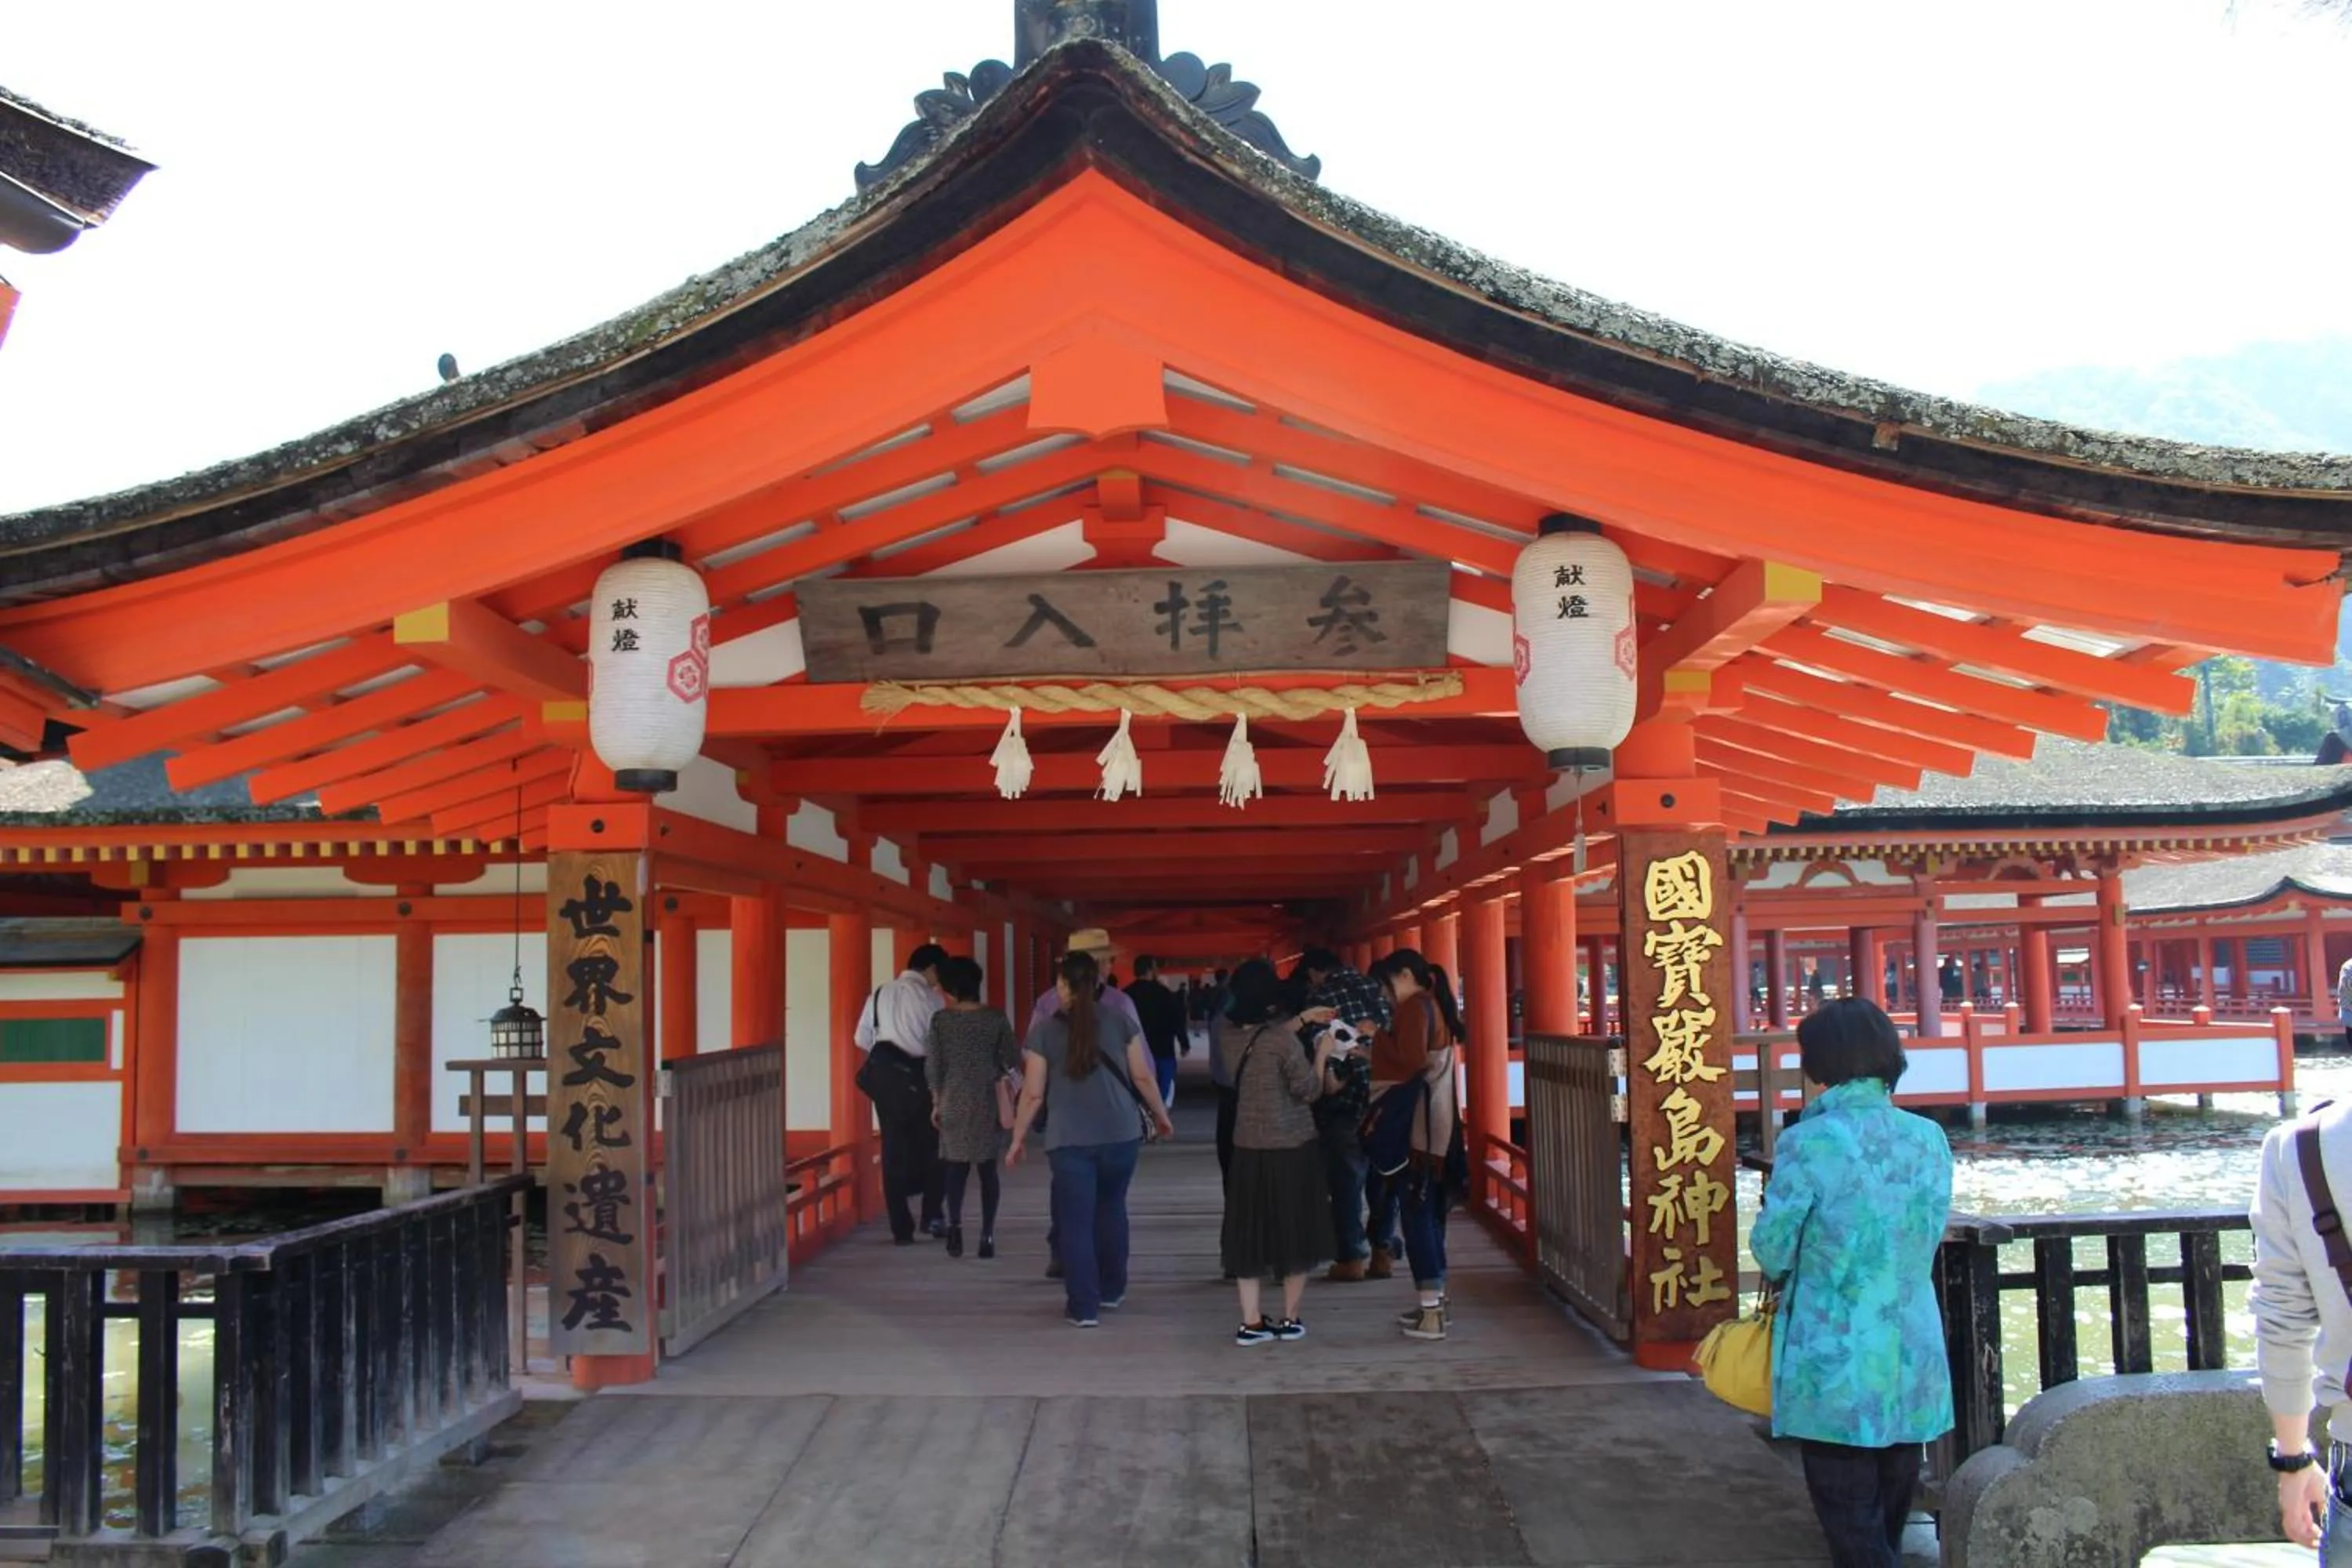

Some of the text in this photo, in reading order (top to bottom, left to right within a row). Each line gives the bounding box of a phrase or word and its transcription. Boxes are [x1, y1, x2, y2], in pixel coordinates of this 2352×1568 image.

[1554, 564, 1588, 619] 献燈
[612, 598, 640, 652] 献燈
[559, 873, 634, 1331] 世界文化遺産
